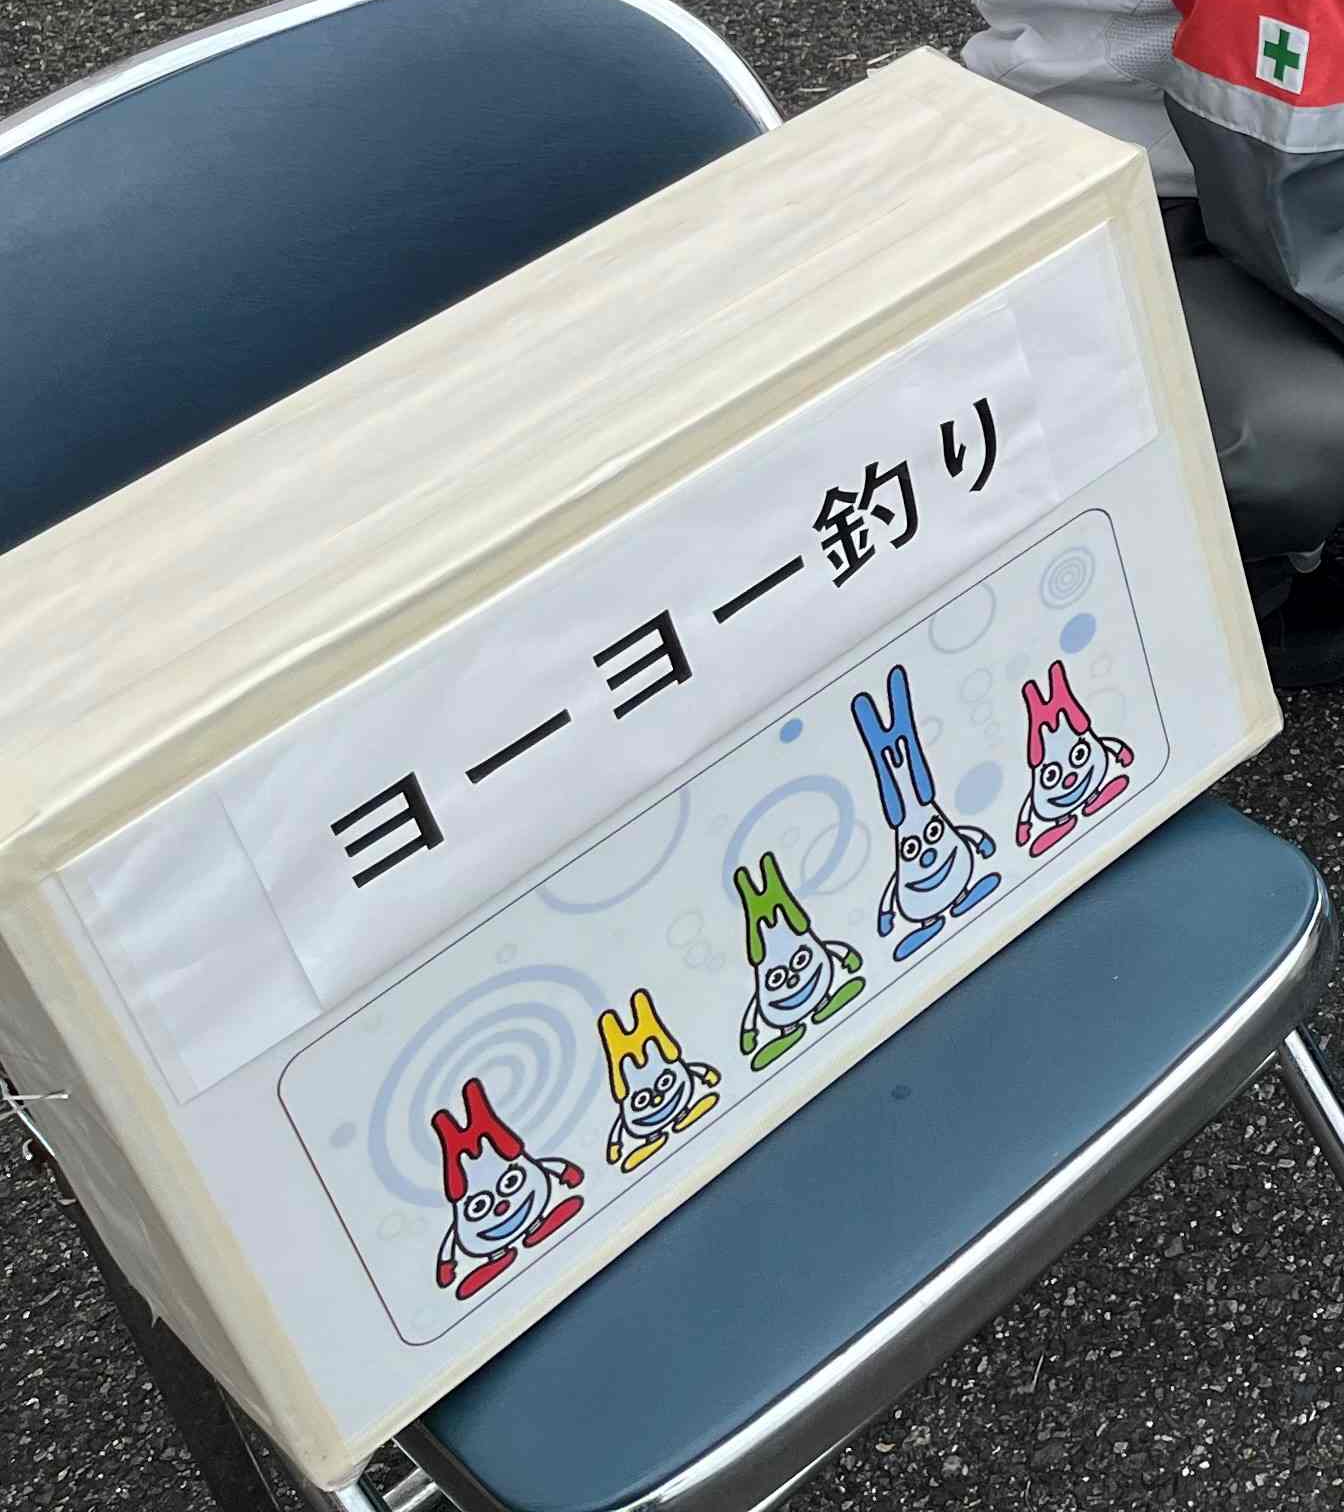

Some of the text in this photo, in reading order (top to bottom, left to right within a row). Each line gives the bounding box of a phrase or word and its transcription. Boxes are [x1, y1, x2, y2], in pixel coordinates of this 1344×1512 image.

[330, 397, 998, 889] ヨーヨー釣り
